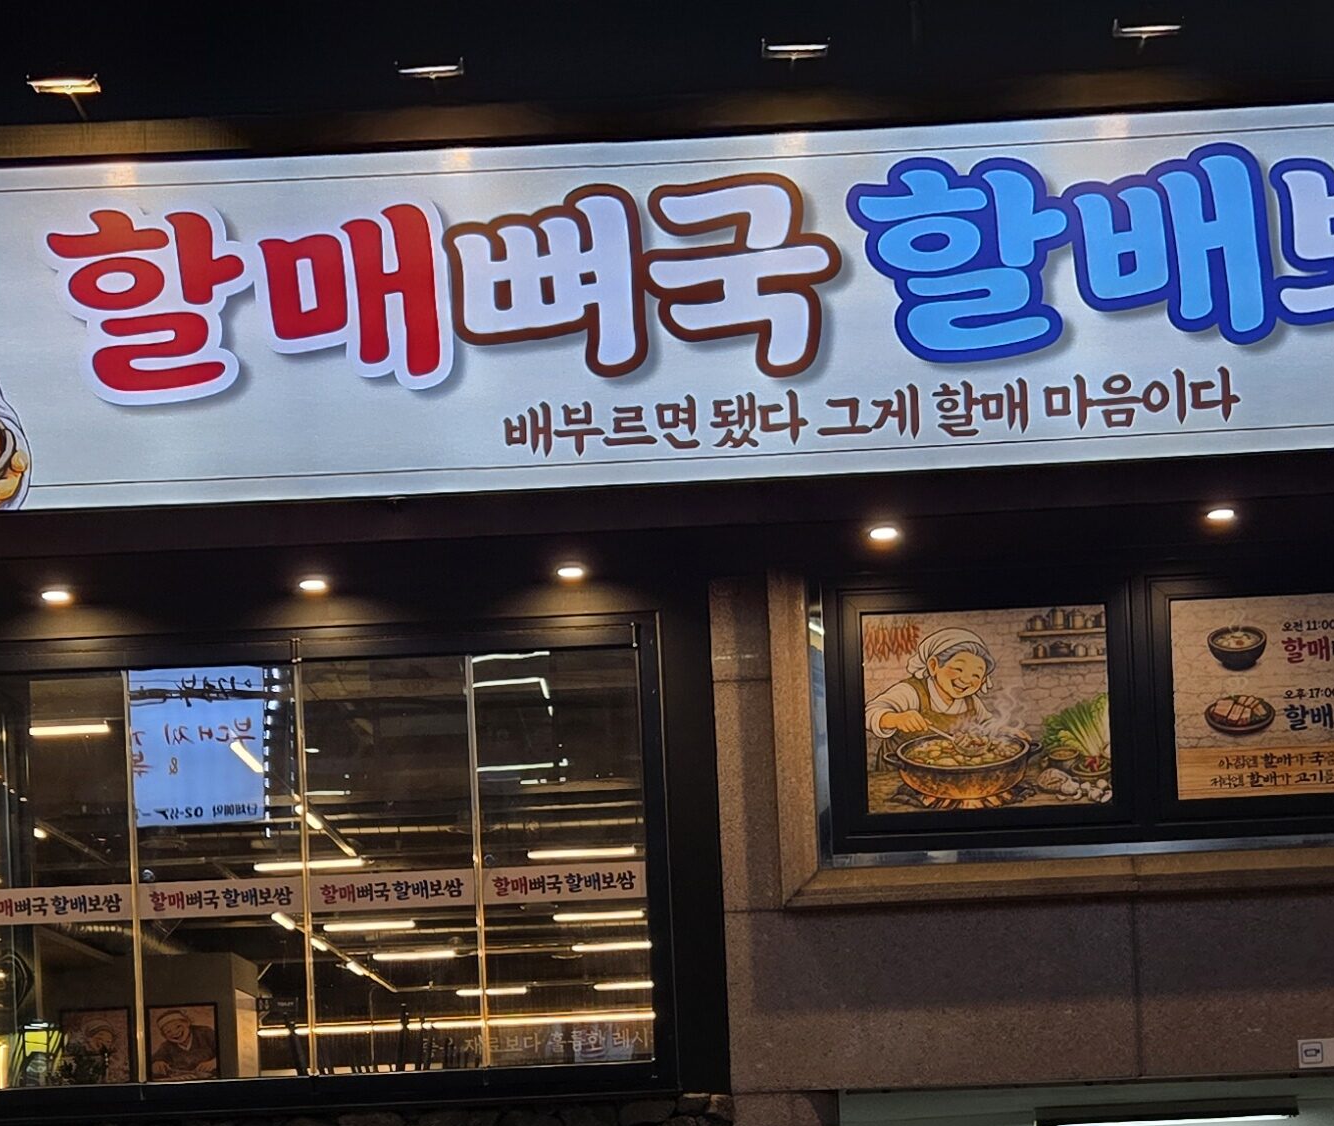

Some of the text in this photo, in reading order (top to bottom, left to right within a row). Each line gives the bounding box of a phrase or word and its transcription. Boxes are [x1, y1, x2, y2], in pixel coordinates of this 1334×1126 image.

[46, 173, 841, 398] 할매뼈국
[504, 367, 1242, 456] 배부르면 됐다 그게 할매 마음이다
[1281, 620, 1304, 632] 오전
[1283, 689, 1306, 700] 오후
[1260, 752, 1306, 769] 할매가
[1247, 771, 1291, 787] 할배가
[1294, 770, 1334, 784] 고기를
[320, 878, 464, 904] 할매뼈국 할배보쌈
[492, 871, 636, 896] 할매뼈국 할배보쌈
[51, 895, 122, 915] 할배보쌈
[149, 886, 293, 912] 할매뼈국 할배보쌈
[612, 1027, 655, 1051] 레시
